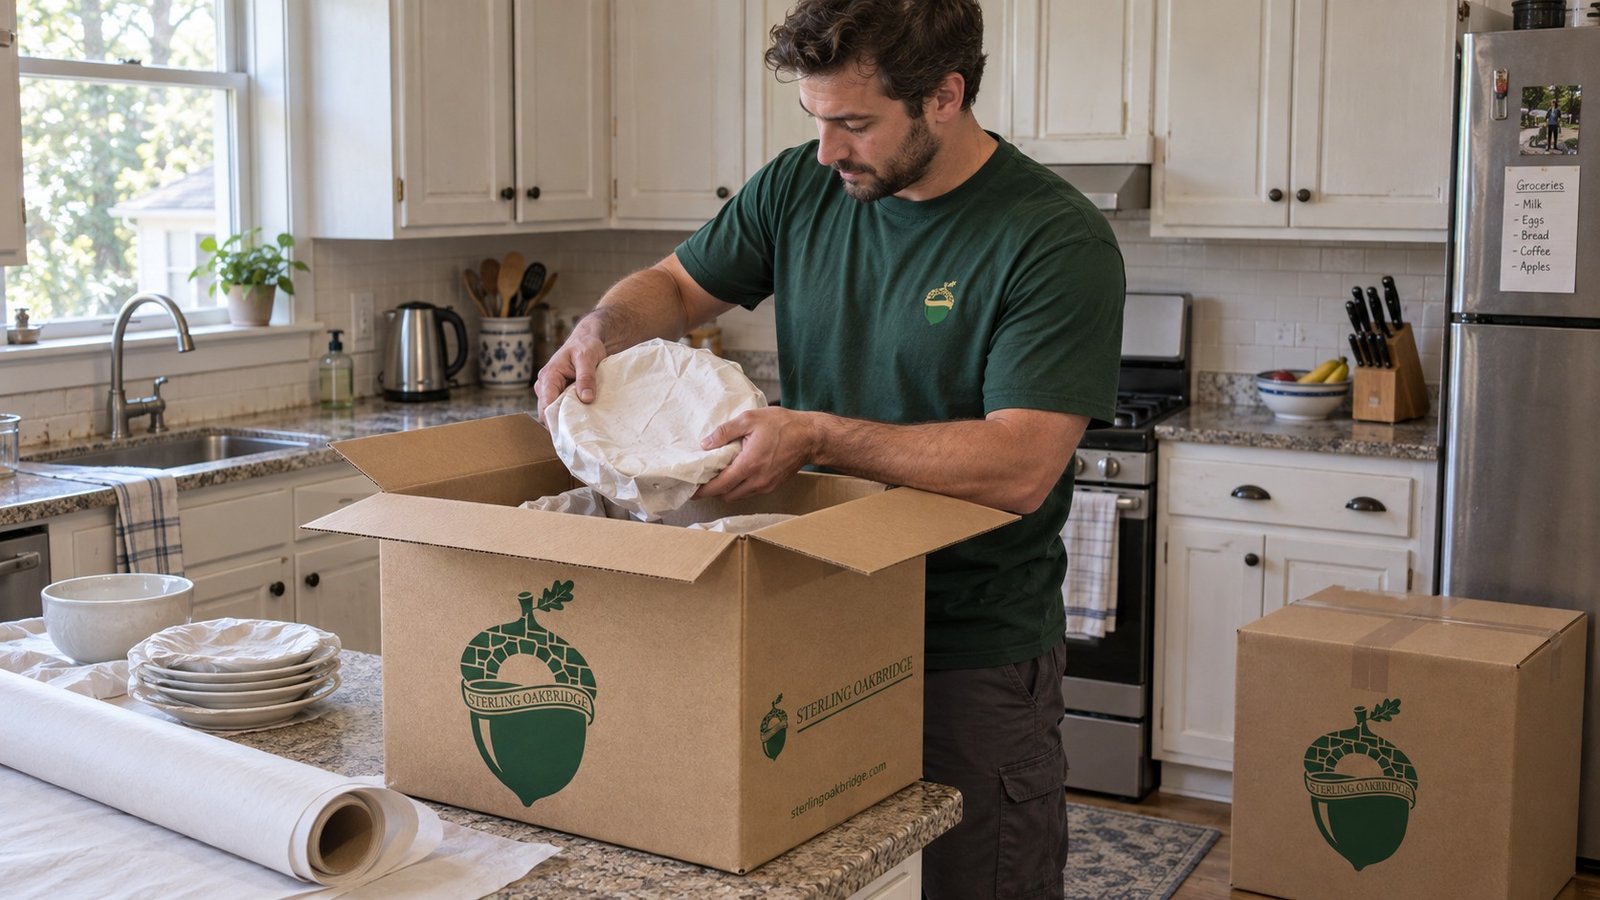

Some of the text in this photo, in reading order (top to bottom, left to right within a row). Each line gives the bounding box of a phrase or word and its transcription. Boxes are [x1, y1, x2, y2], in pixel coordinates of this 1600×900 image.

[1516, 179, 1565, 190] Groceries
[1523, 199, 1542, 209] Milk
[1522, 215, 1544, 228] Eggs
[1521, 230, 1549, 240] Bread
[1520, 246, 1551, 256] Coffee
[1520, 261, 1550, 274] Apples
[796, 656, 913, 724] STERLING OAKBRIDGE
[468, 690, 588, 708] STERLING OAKBRIDGE
[791, 762, 887, 819] sterlingoakbridge.com
[1310, 783, 1354, 794] STERLING
